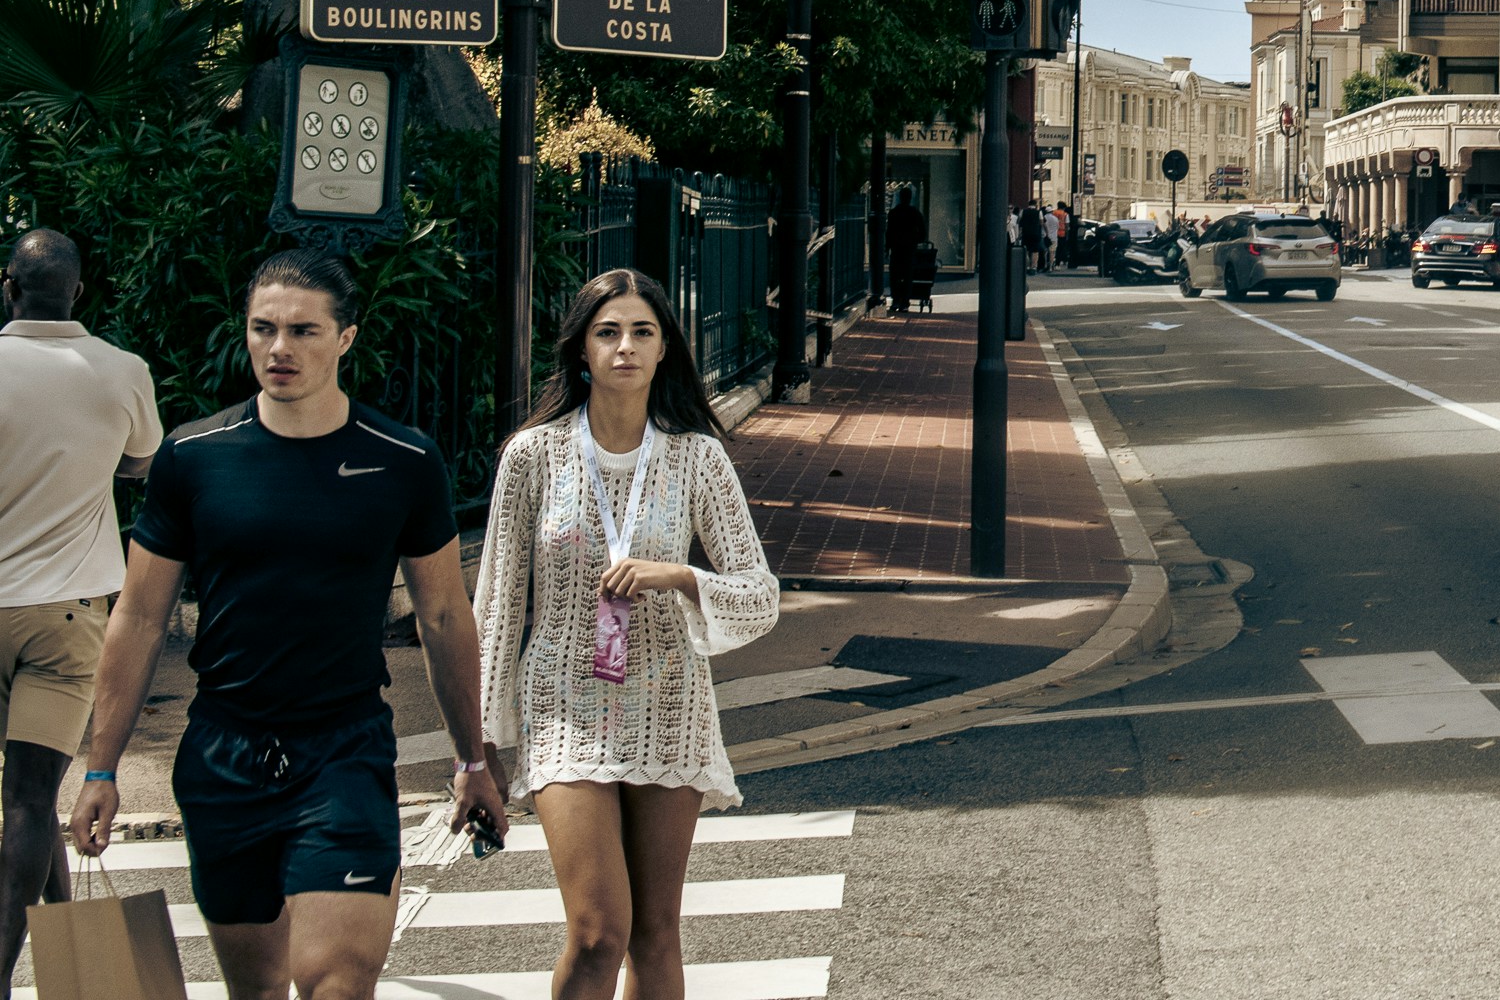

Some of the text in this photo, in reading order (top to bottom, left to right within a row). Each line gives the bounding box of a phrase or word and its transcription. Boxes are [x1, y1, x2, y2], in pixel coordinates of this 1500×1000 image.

[327, 6, 482, 31] BOULINGRINS
[606, 19, 673, 43] COSTA
[906, 129, 957, 141] ENETA
